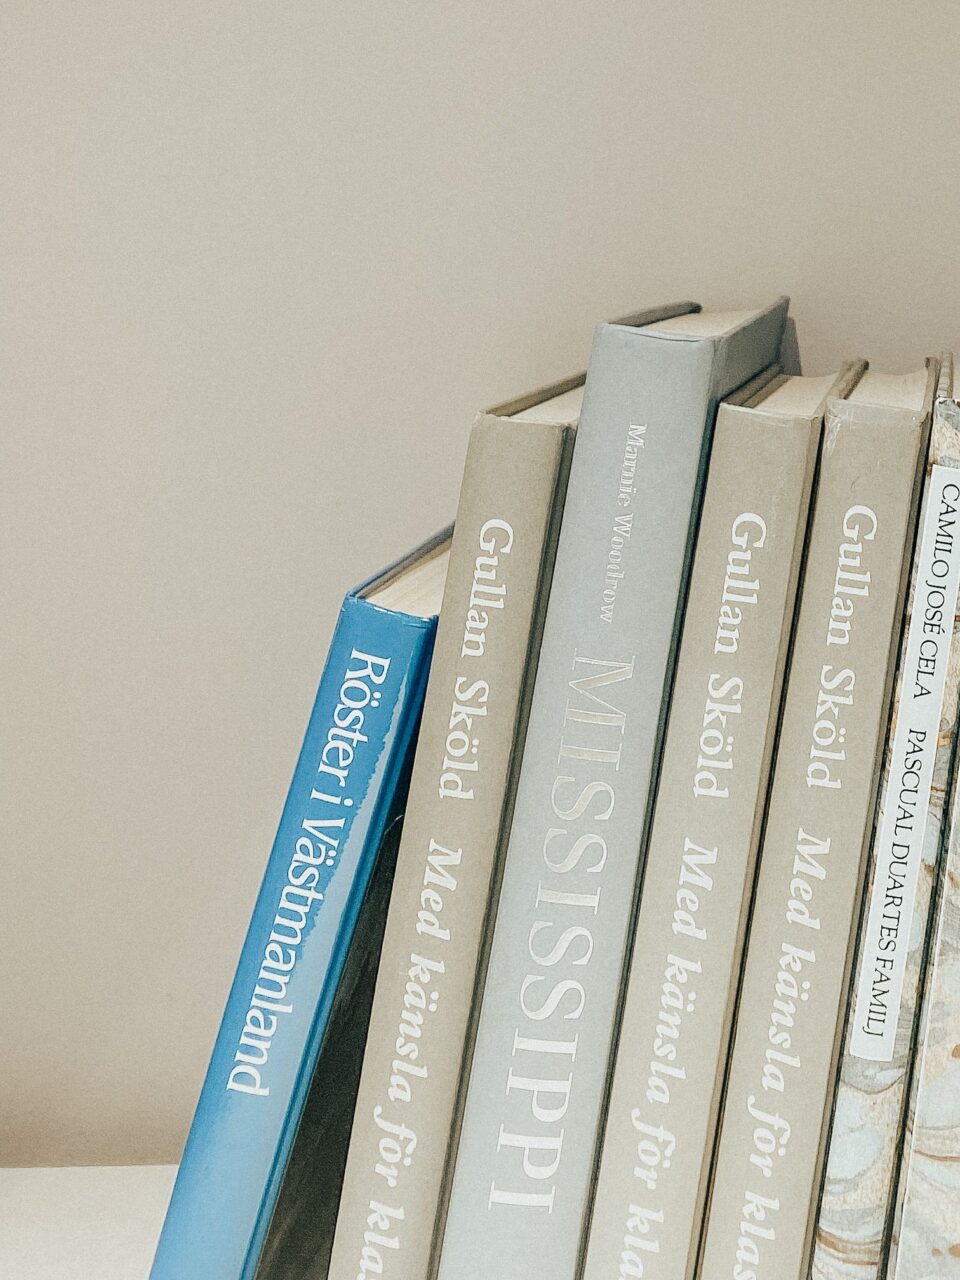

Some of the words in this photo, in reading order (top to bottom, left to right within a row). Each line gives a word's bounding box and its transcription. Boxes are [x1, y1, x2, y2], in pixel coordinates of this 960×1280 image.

[617, 423, 648, 507] Marnie
[599, 513, 634, 624] Woodrow
[714, 511, 768, 655] Gullan
[826, 504, 878, 647] Gullan
[931, 483, 960, 579] CAMILO
[461, 518, 514, 658] Gullan
[922, 580, 947, 635] JOSÉ
[317, 647, 392, 786] Röster
[913, 639, 939, 700] CELA
[438, 676, 490, 800] Sköld
[693, 673, 744, 799] Sköld
[806, 664, 856, 789] Sköld
[310, 787, 354, 809] i
[894, 728, 927, 836] PASCUAL
[416, 838, 462, 941] Med
[487, 649, 636, 1215] MISSISSIPPI
[671, 837, 718, 940] Med
[786, 827, 831, 930] Med
[877, 841, 910, 954] DUARTES
[226, 814, 345, 1096] Västmanland
[862, 957, 894, 1038] FAMILJ
[388, 952, 445, 1103] känsla
[646, 953, 703, 1104] känsla
[761, 942, 816, 1093] känsla
[373, 1104, 418, 1188] för
[630, 1107, 676, 1190] för
[747, 1095, 792, 1178] för
[356, 1199, 405, 1280] kla
[618, 1203, 665, 1280] kla
